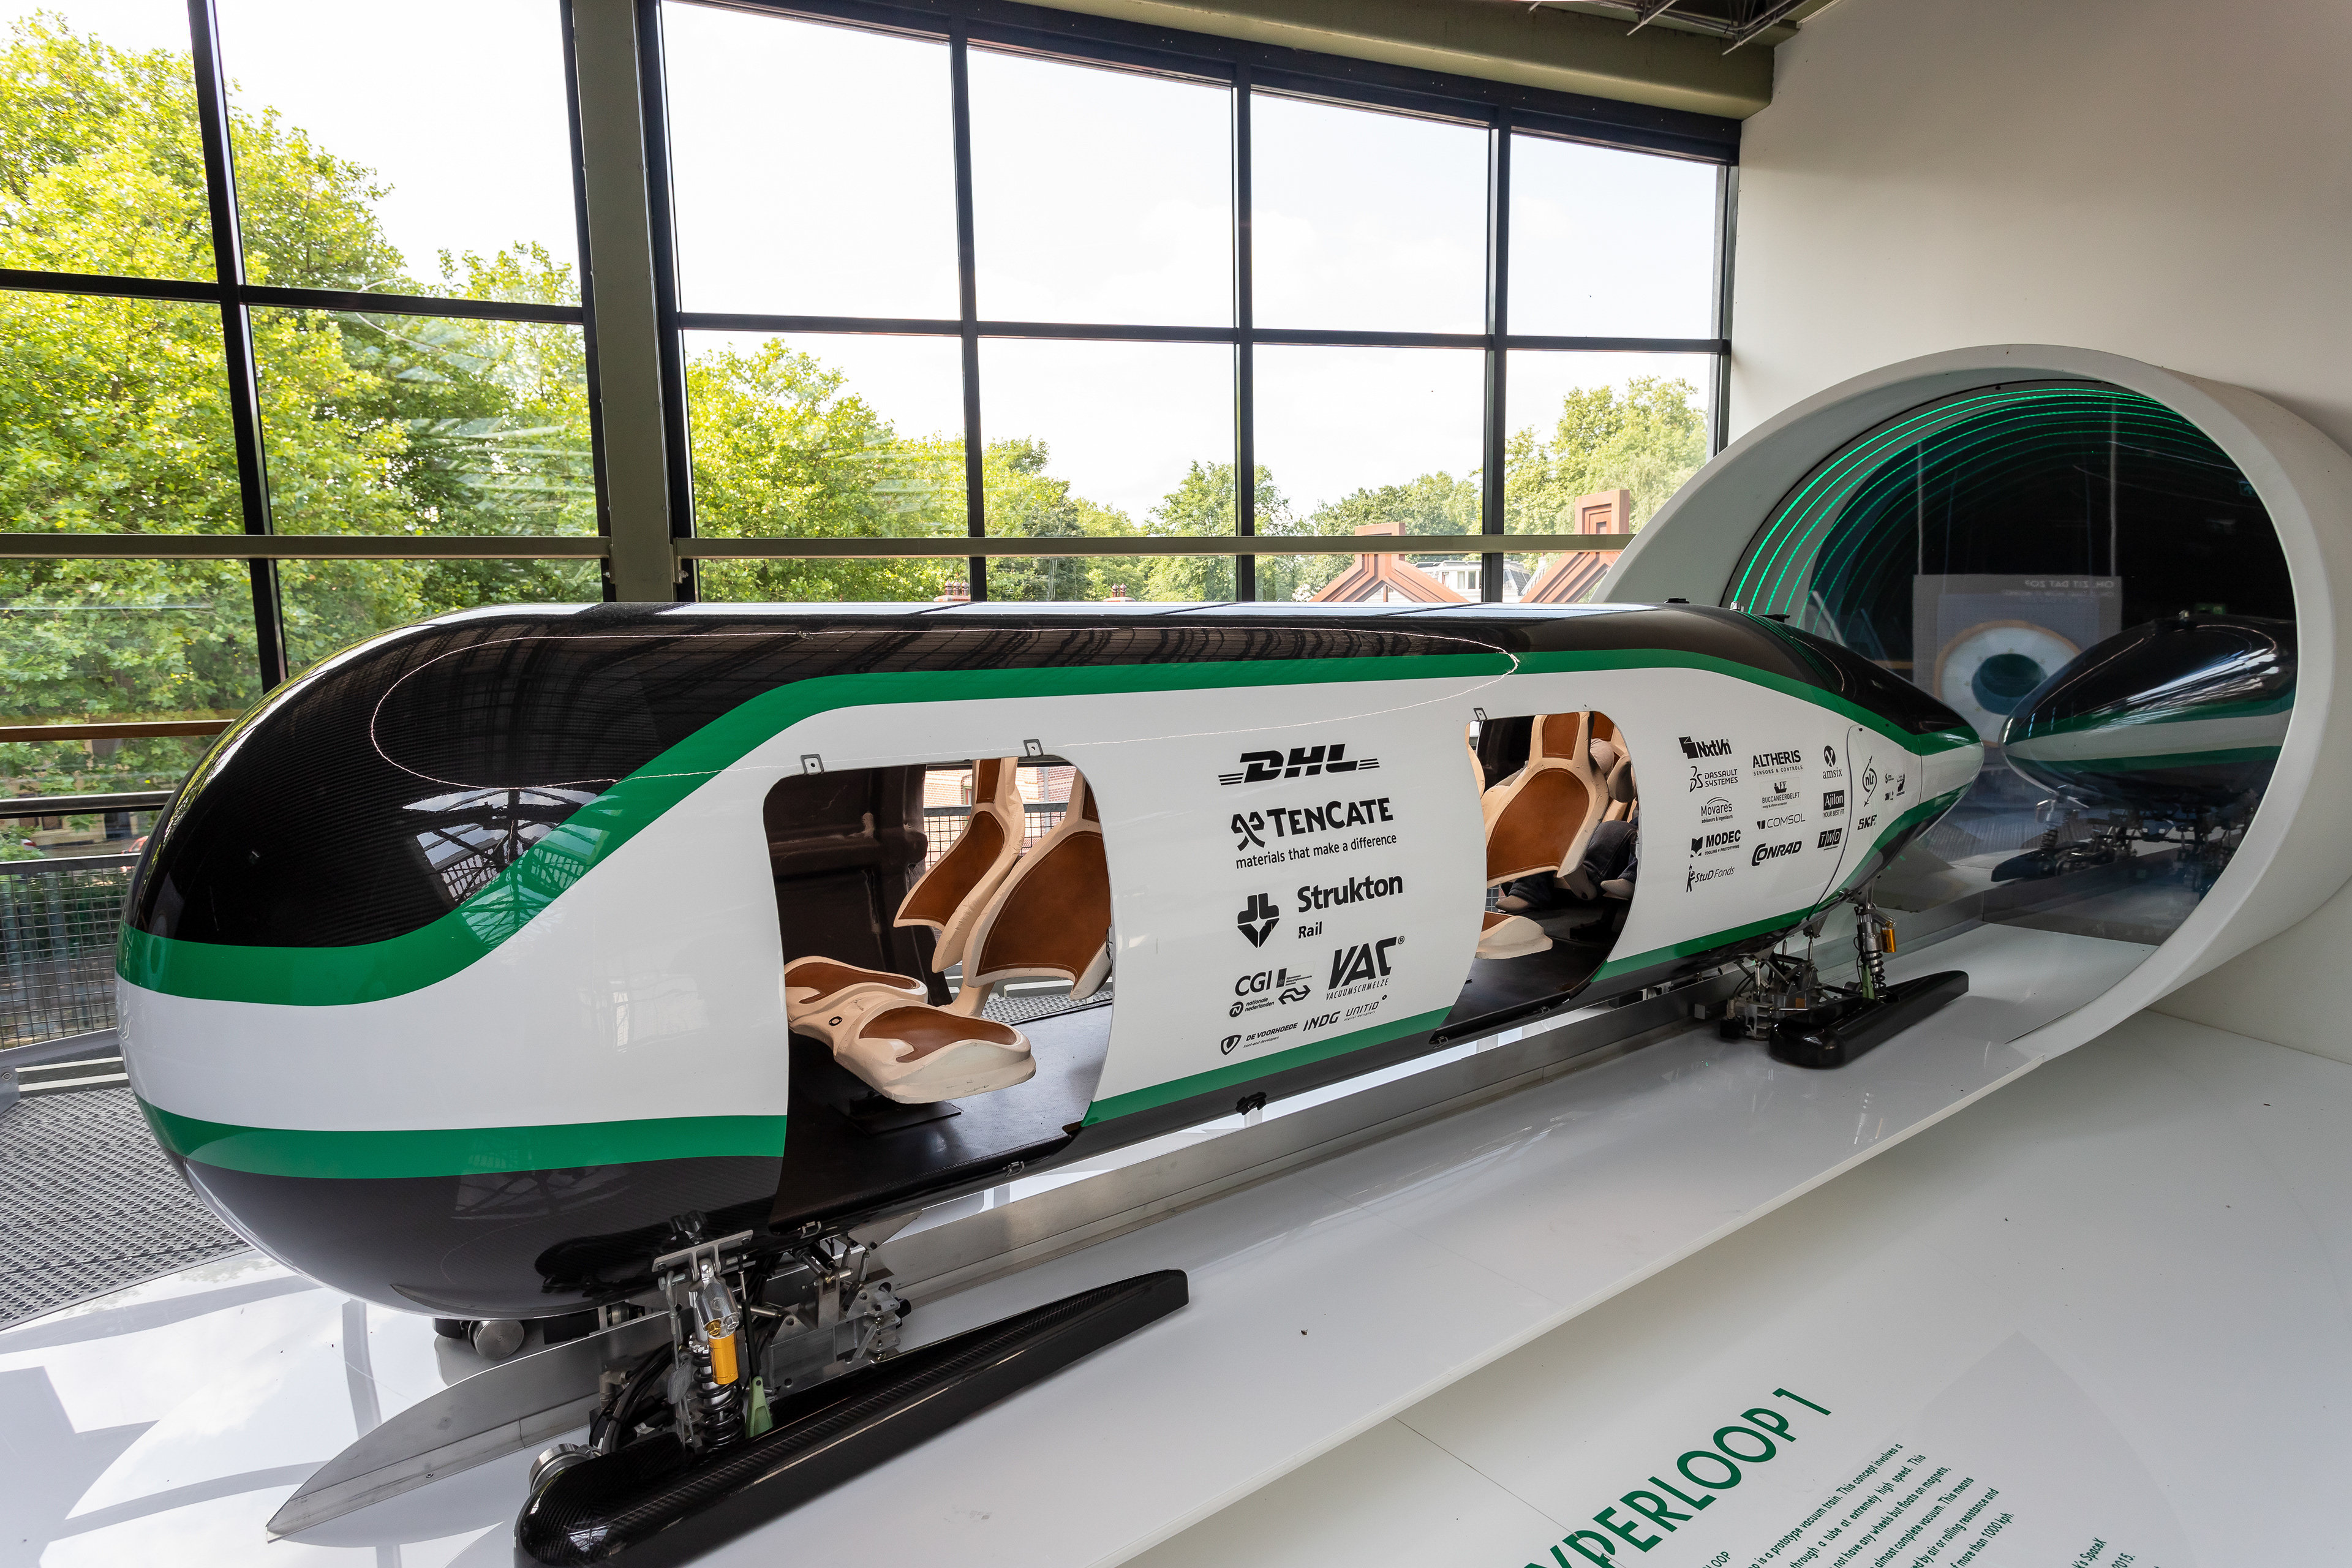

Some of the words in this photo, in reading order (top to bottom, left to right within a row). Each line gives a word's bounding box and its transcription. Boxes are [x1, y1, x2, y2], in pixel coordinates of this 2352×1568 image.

[1240, 744, 1358, 783] DHL
[1752, 750, 1801, 768] ALTHERIS
[1704, 769, 1738, 779] DASSAULT
[1823, 767, 1842, 779] amsix
[1701, 803, 1733, 816] Movares
[1825, 793, 1844, 809] Ajilon
[1767, 813, 1806, 828] COMSOL
[1705, 829, 1741, 848] MODEC
[1820, 832, 1841, 845] TWD
[1236, 851, 1286, 869] materials
[1288, 846, 1311, 861] that
[1313, 842, 1340, 857] make
[1343, 842, 1348, 851] a
[1351, 834, 1397, 850] difference
[1751, 840, 1802, 867] CONRAD
[1297, 875, 1403, 912] Strukton
[1298, 921, 1322, 938] Rail
[1235, 970, 1273, 997] CGI
[1326, 978, 1389, 1001] VACUUMSCHMELZE
[1257, 1022, 1298, 1039] VOORHOEDE
[1303, 1011, 1341, 1031] INDG
[1772, 1387, 1831, 1416] 1
[1770, 1528, 1803, 1556] prototype
[1799, 1507, 1827, 1529] vacuum
[1822, 1495, 1844, 1509] train.
[1836, 1482, 1856, 1495] This
[1853, 1464, 1877, 1485] concept
[1870, 1452, 1899, 1467] involves
[1790, 1547, 1820, 1568] through
[1823, 1527, 1842, 1540] tube
[1841, 1519, 1852, 1528] at
[1849, 1494, 1882, 1520] extremely
[1874, 1482, 1894, 1495] high
[1892, 1466, 1913, 1482] speed.
[1907, 1454, 1926, 1465] This
[1833, 1556, 1849, 1568] not
[1841, 1544, 1863, 1559] have
[1859, 1532, 1877, 1545] any
[1870, 1517, 1894, 1536] wheels
[1887, 1507, 1904, 1518] but
[1897, 1493, 1919, 1509] floats
[1915, 1486, 1927, 1495] on
[1922, 1466, 1952, 1488] magnets,
[1874, 1547, 1899, 1568] almost
[1894, 1525, 1924, 1550] complete
[1918, 1505, 1947, 1526] vacuum.
[1937, 1493, 1958, 1504] This
[1953, 1477, 1974, 1494] means
[1916, 1554, 1934, 1564] by
[1927, 1546, 1940, 1556] air
[1936, 1539, 1947, 1548] or
[1942, 1523, 1967, 1542] rolling
[1959, 1498, 1989, 1525] resistance
[1985, 1487, 2000, 1499] and
[1957, 1551, 1976, 1567] more
[1969, 1538, 1989, 1552] than
[1981, 1521, 2003, 1538] 1000
[1994, 1512, 2015, 1525] kph.
[2079, 1537, 2107, 1561] SpaceX
